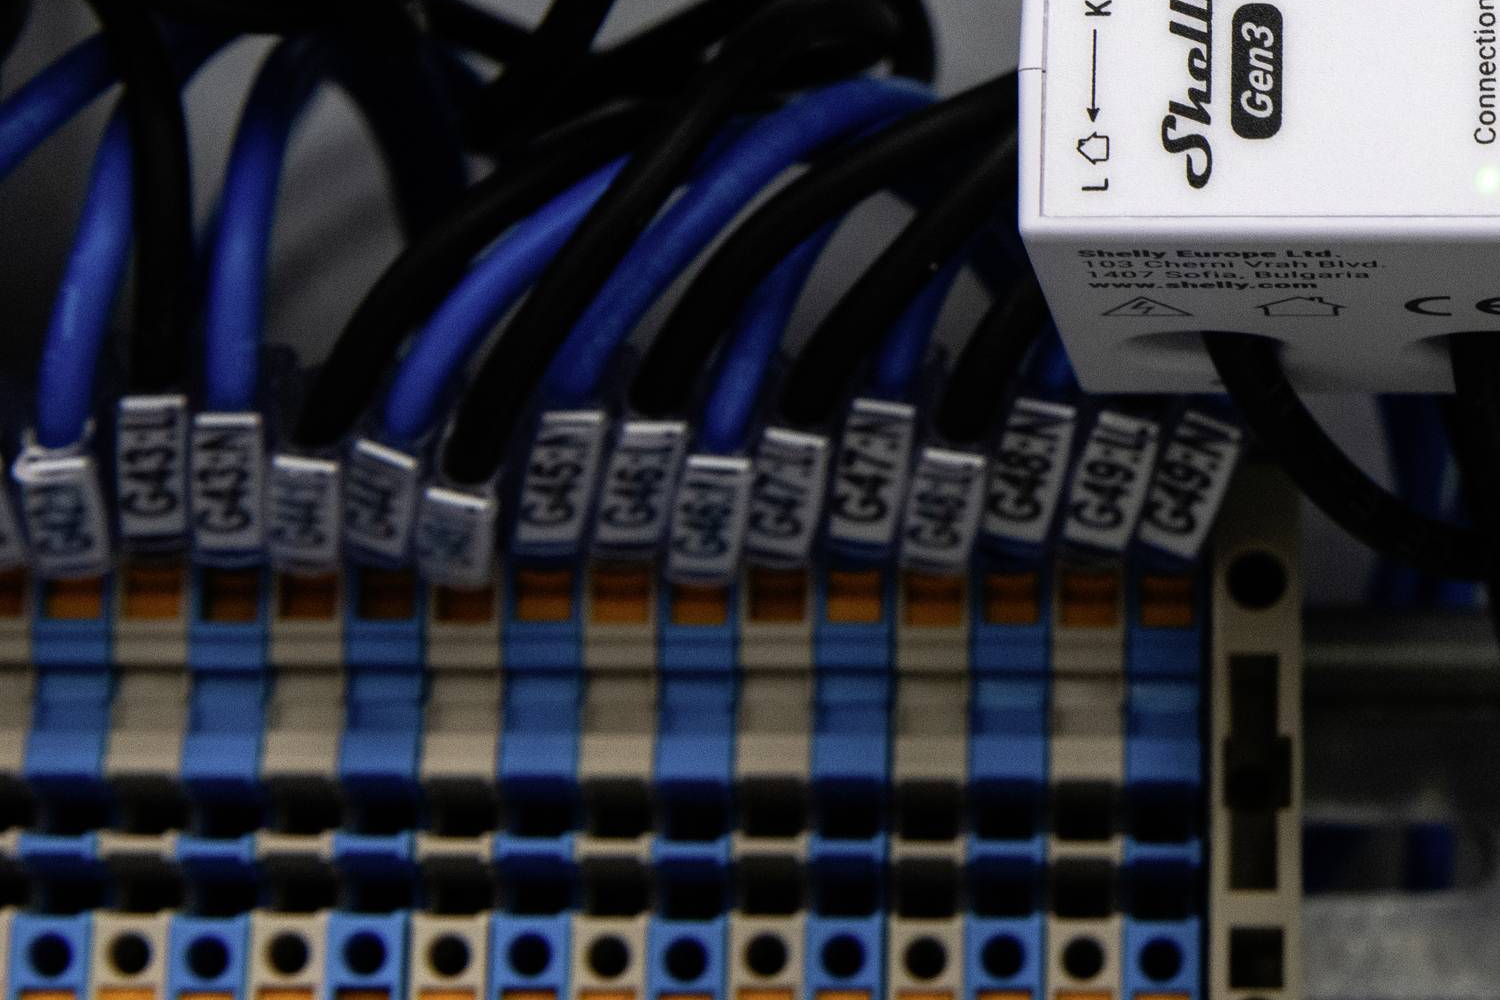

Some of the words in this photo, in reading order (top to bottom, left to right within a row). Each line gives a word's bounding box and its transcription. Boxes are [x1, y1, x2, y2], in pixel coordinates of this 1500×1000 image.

[1085, 0, 1112, 16] K
[1240, 22, 1274, 119] Gen3
[1082, 178, 1109, 191] L
[1077, 249, 1167, 260] Shelly
[1176, 249, 1278, 260] Europe
[1286, 249, 1342, 259] Ltd.
[1083, 260, 1134, 269] 103
[1144, 260, 1235, 269] Cherni
[1318, 260, 1387, 269] Blvd.
[1254, 271, 1370, 281] Bulgaria
[1088, 281, 1318, 290] www.shelly.com
